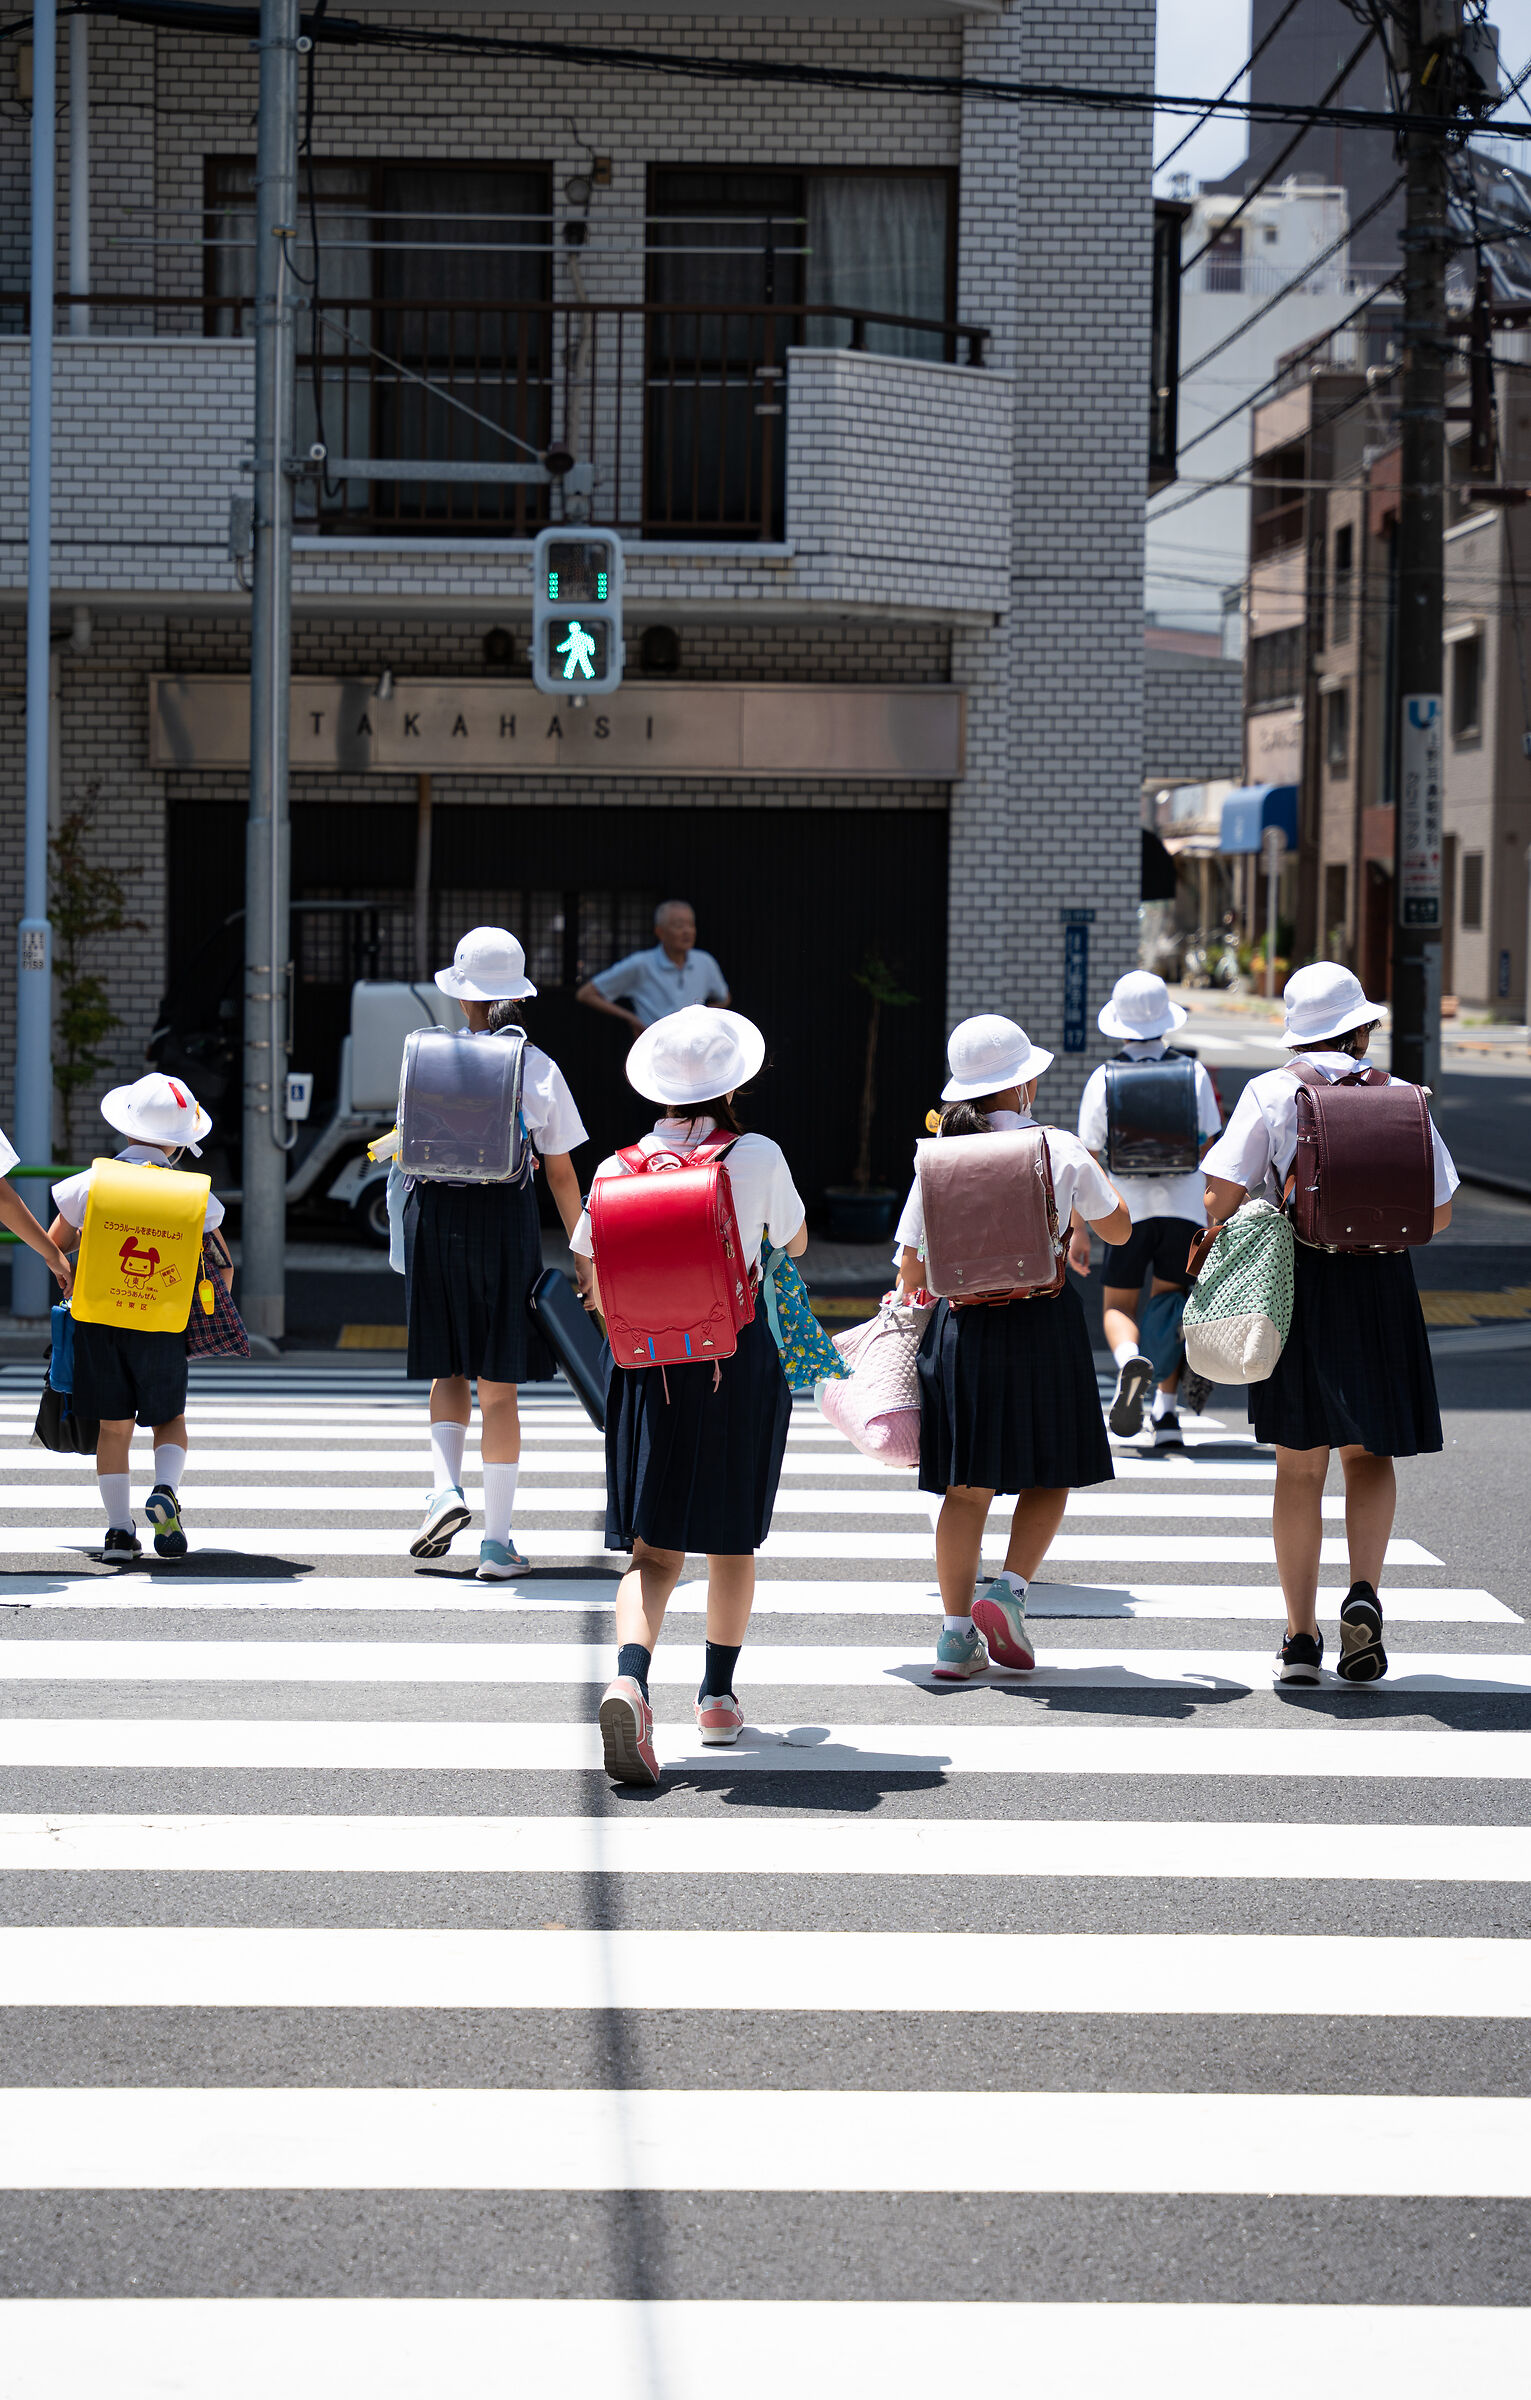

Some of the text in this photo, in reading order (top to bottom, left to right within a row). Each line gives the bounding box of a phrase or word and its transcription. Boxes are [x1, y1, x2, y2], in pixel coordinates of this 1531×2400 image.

[309, 711, 654, 739] TAKAHASI
[109, 1287, 157, 1301] こうつうあんぜん
